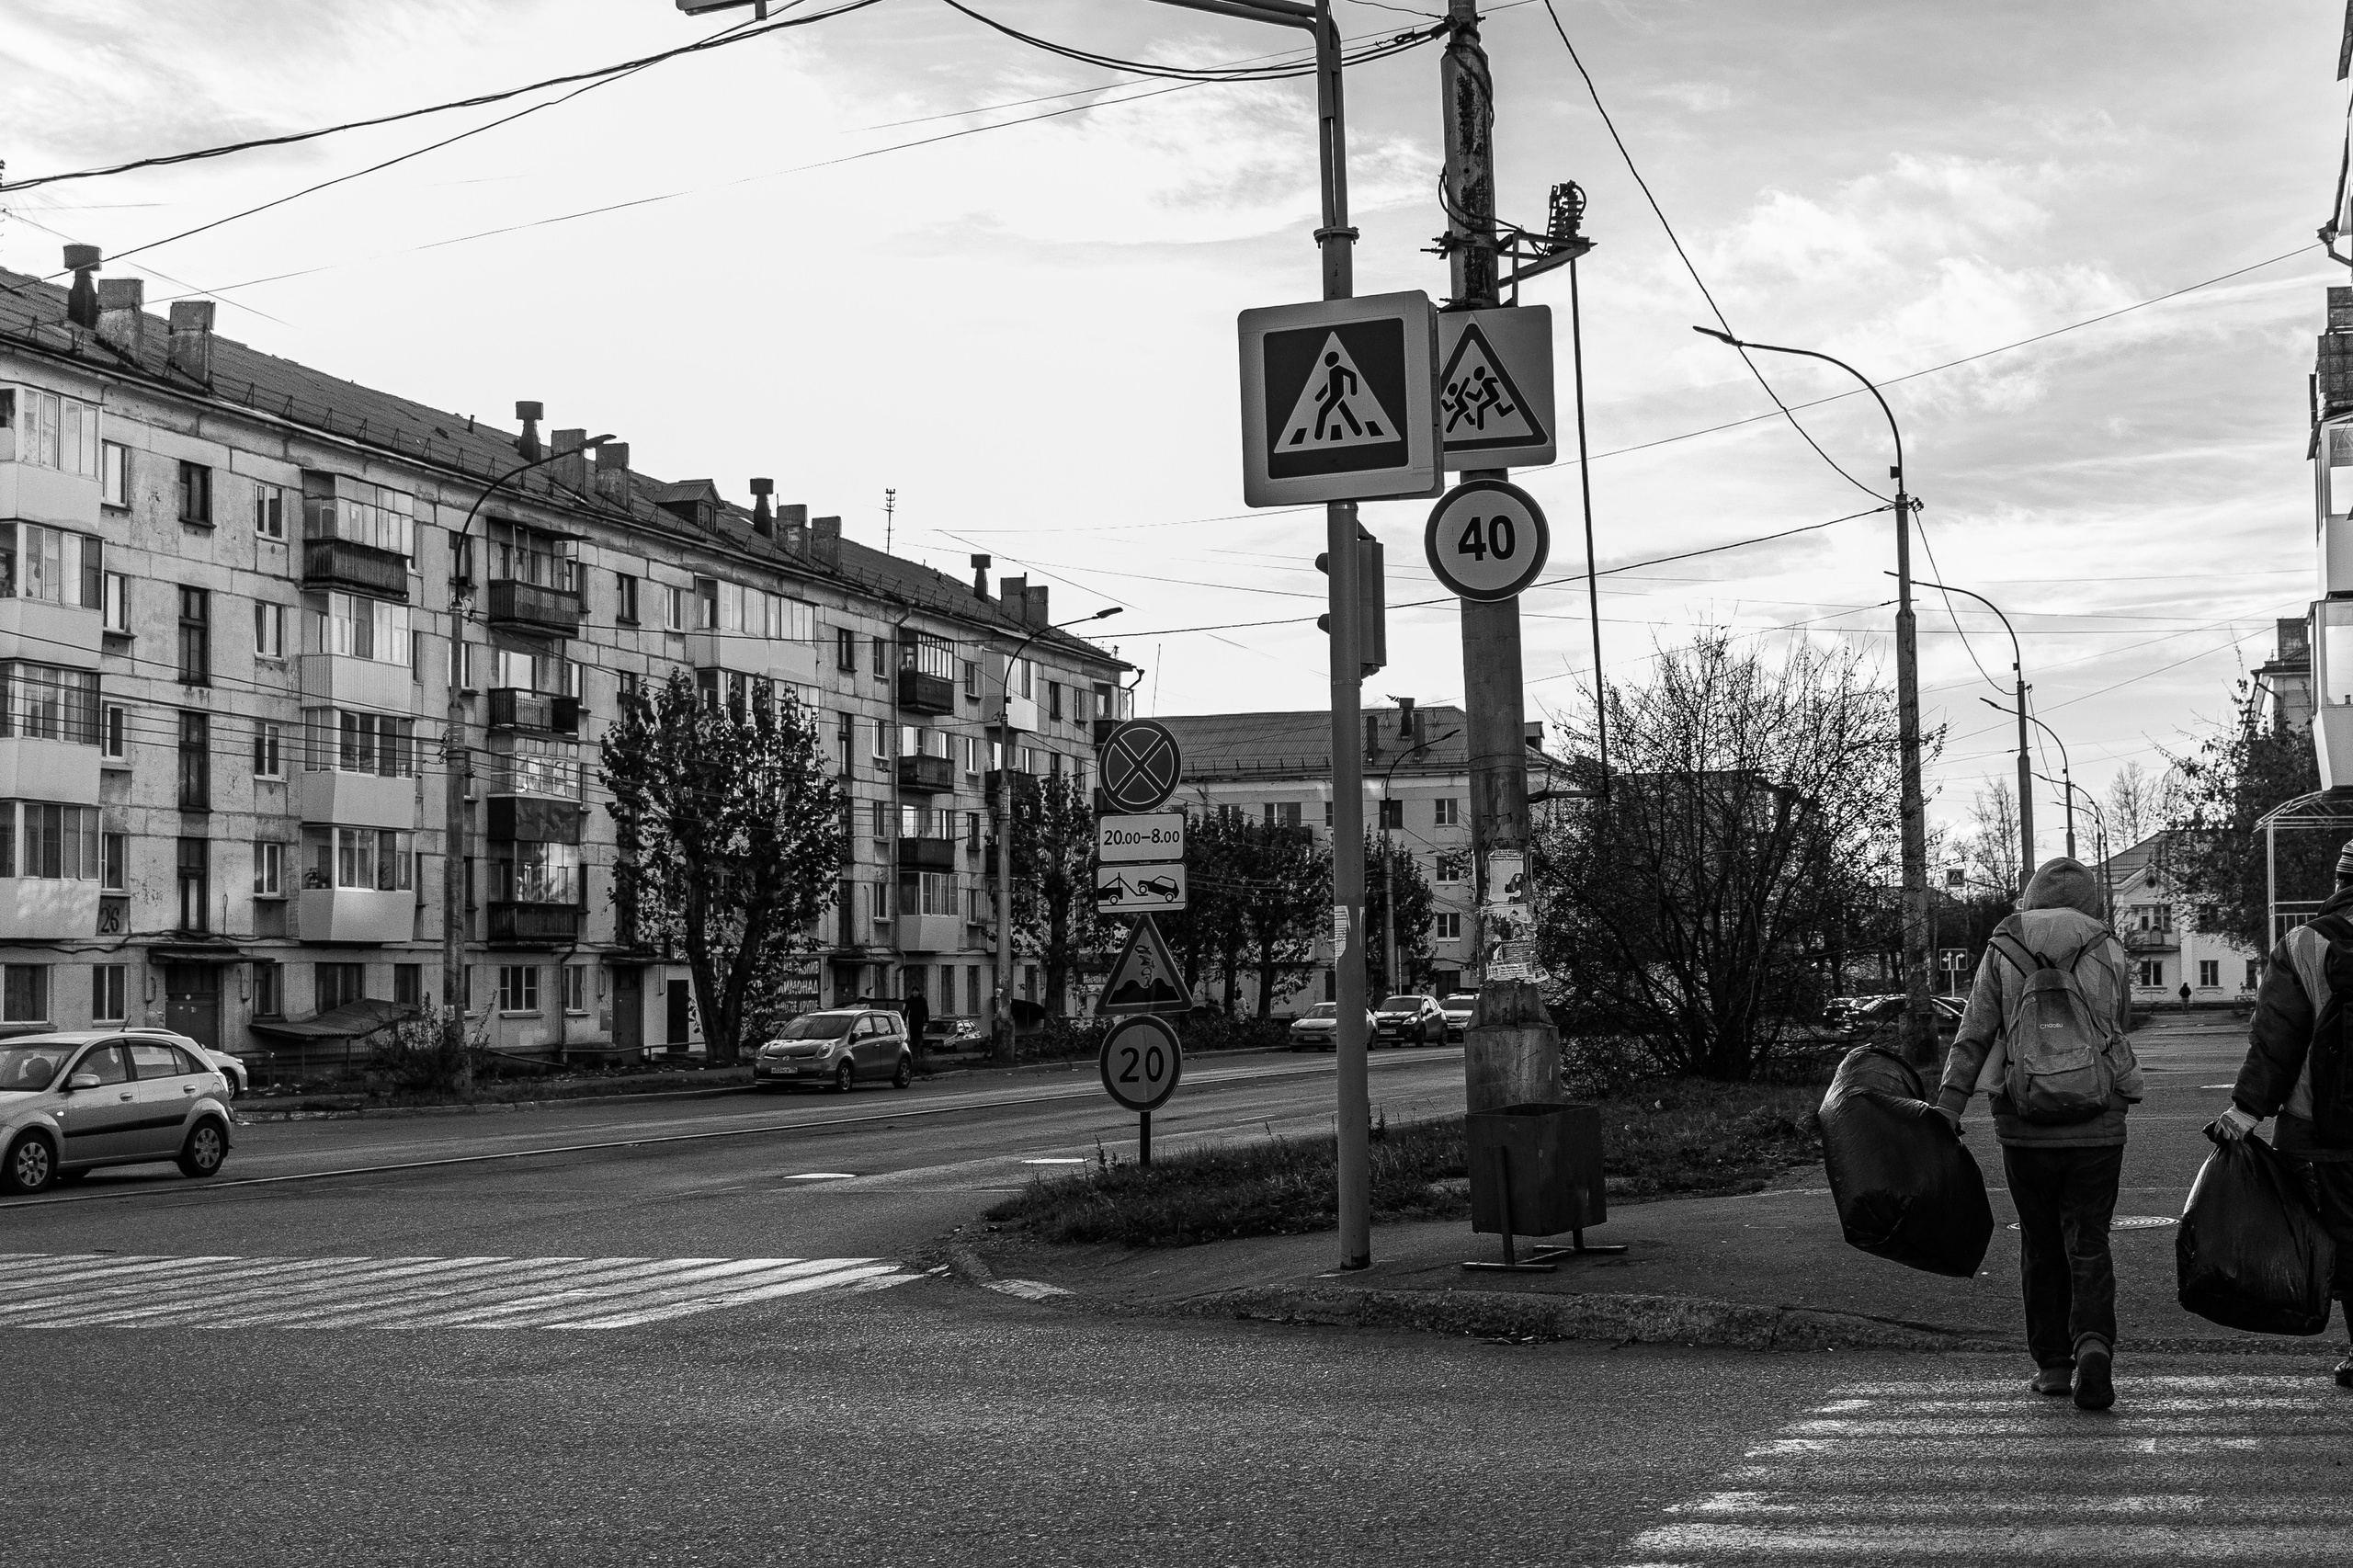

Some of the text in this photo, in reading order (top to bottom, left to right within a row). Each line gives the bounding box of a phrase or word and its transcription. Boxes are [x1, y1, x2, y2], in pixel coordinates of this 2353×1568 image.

[1458, 515, 1516, 562] 40
[101, 907, 119, 933] 26
[778, 979, 819, 994] ЛИМОНАД
[1120, 1045, 1165, 1084] 20
